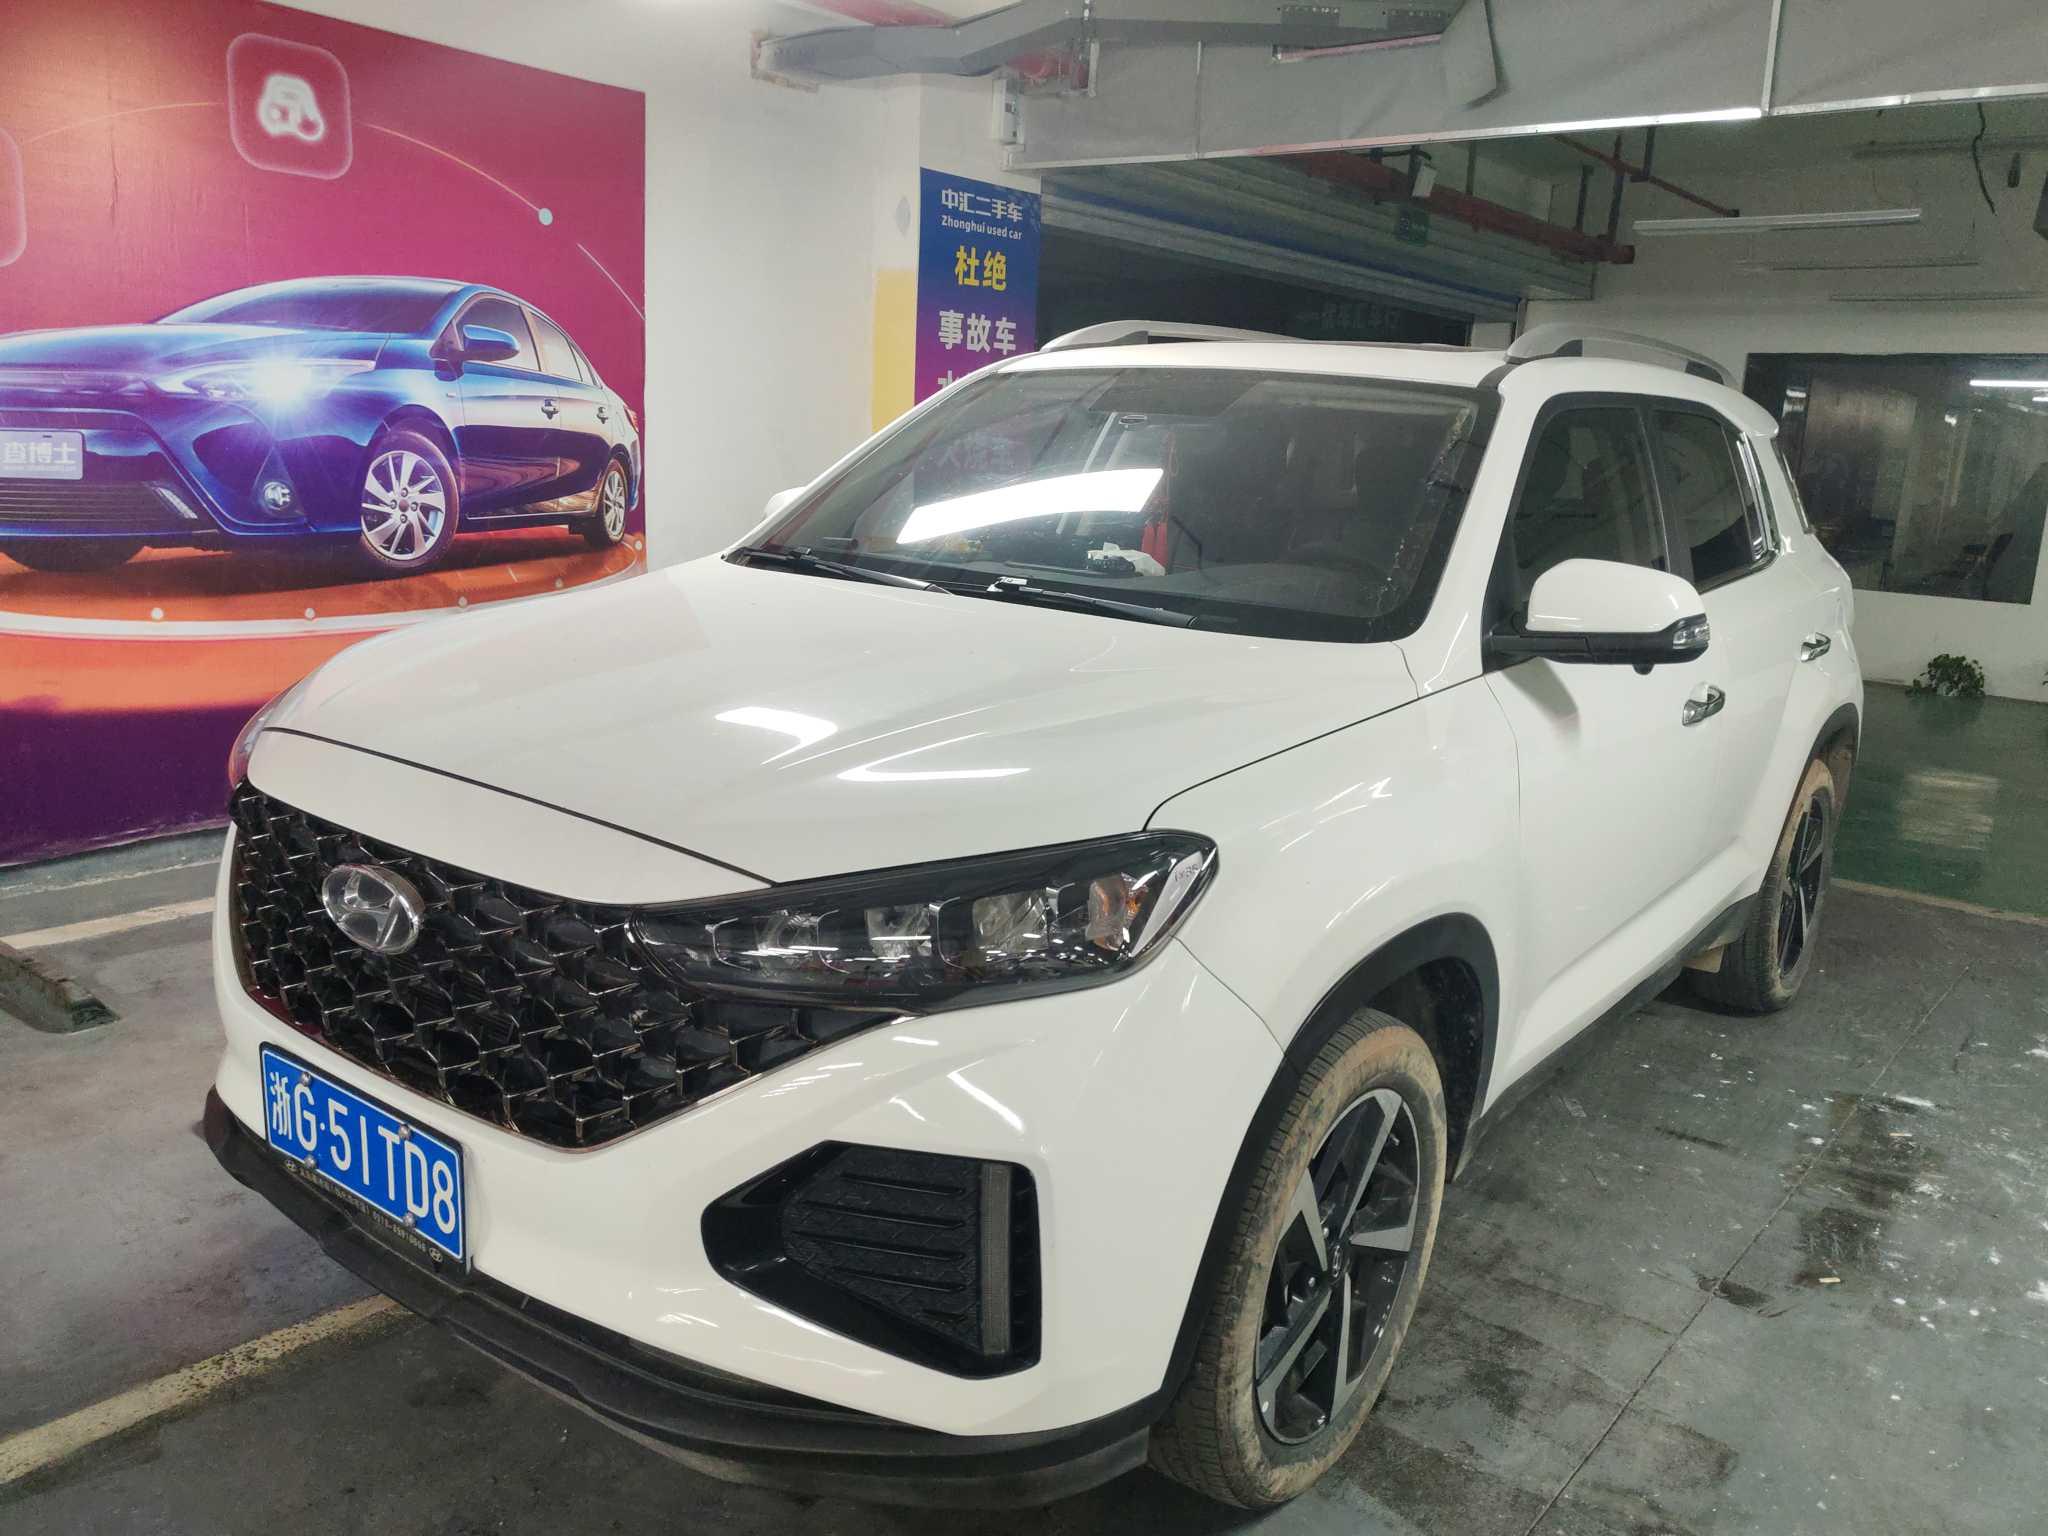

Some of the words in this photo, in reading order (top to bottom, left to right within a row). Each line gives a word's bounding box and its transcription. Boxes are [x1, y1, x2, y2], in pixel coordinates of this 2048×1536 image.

[941, 188, 1023, 222] 中汇二手车
[941, 215, 986, 233] Zhonghui
[987, 224, 1008, 238] used
[1009, 230, 1023, 241] car
[954, 245, 1007, 291] 杜绝
[938, 309, 1017, 355] 事故车
